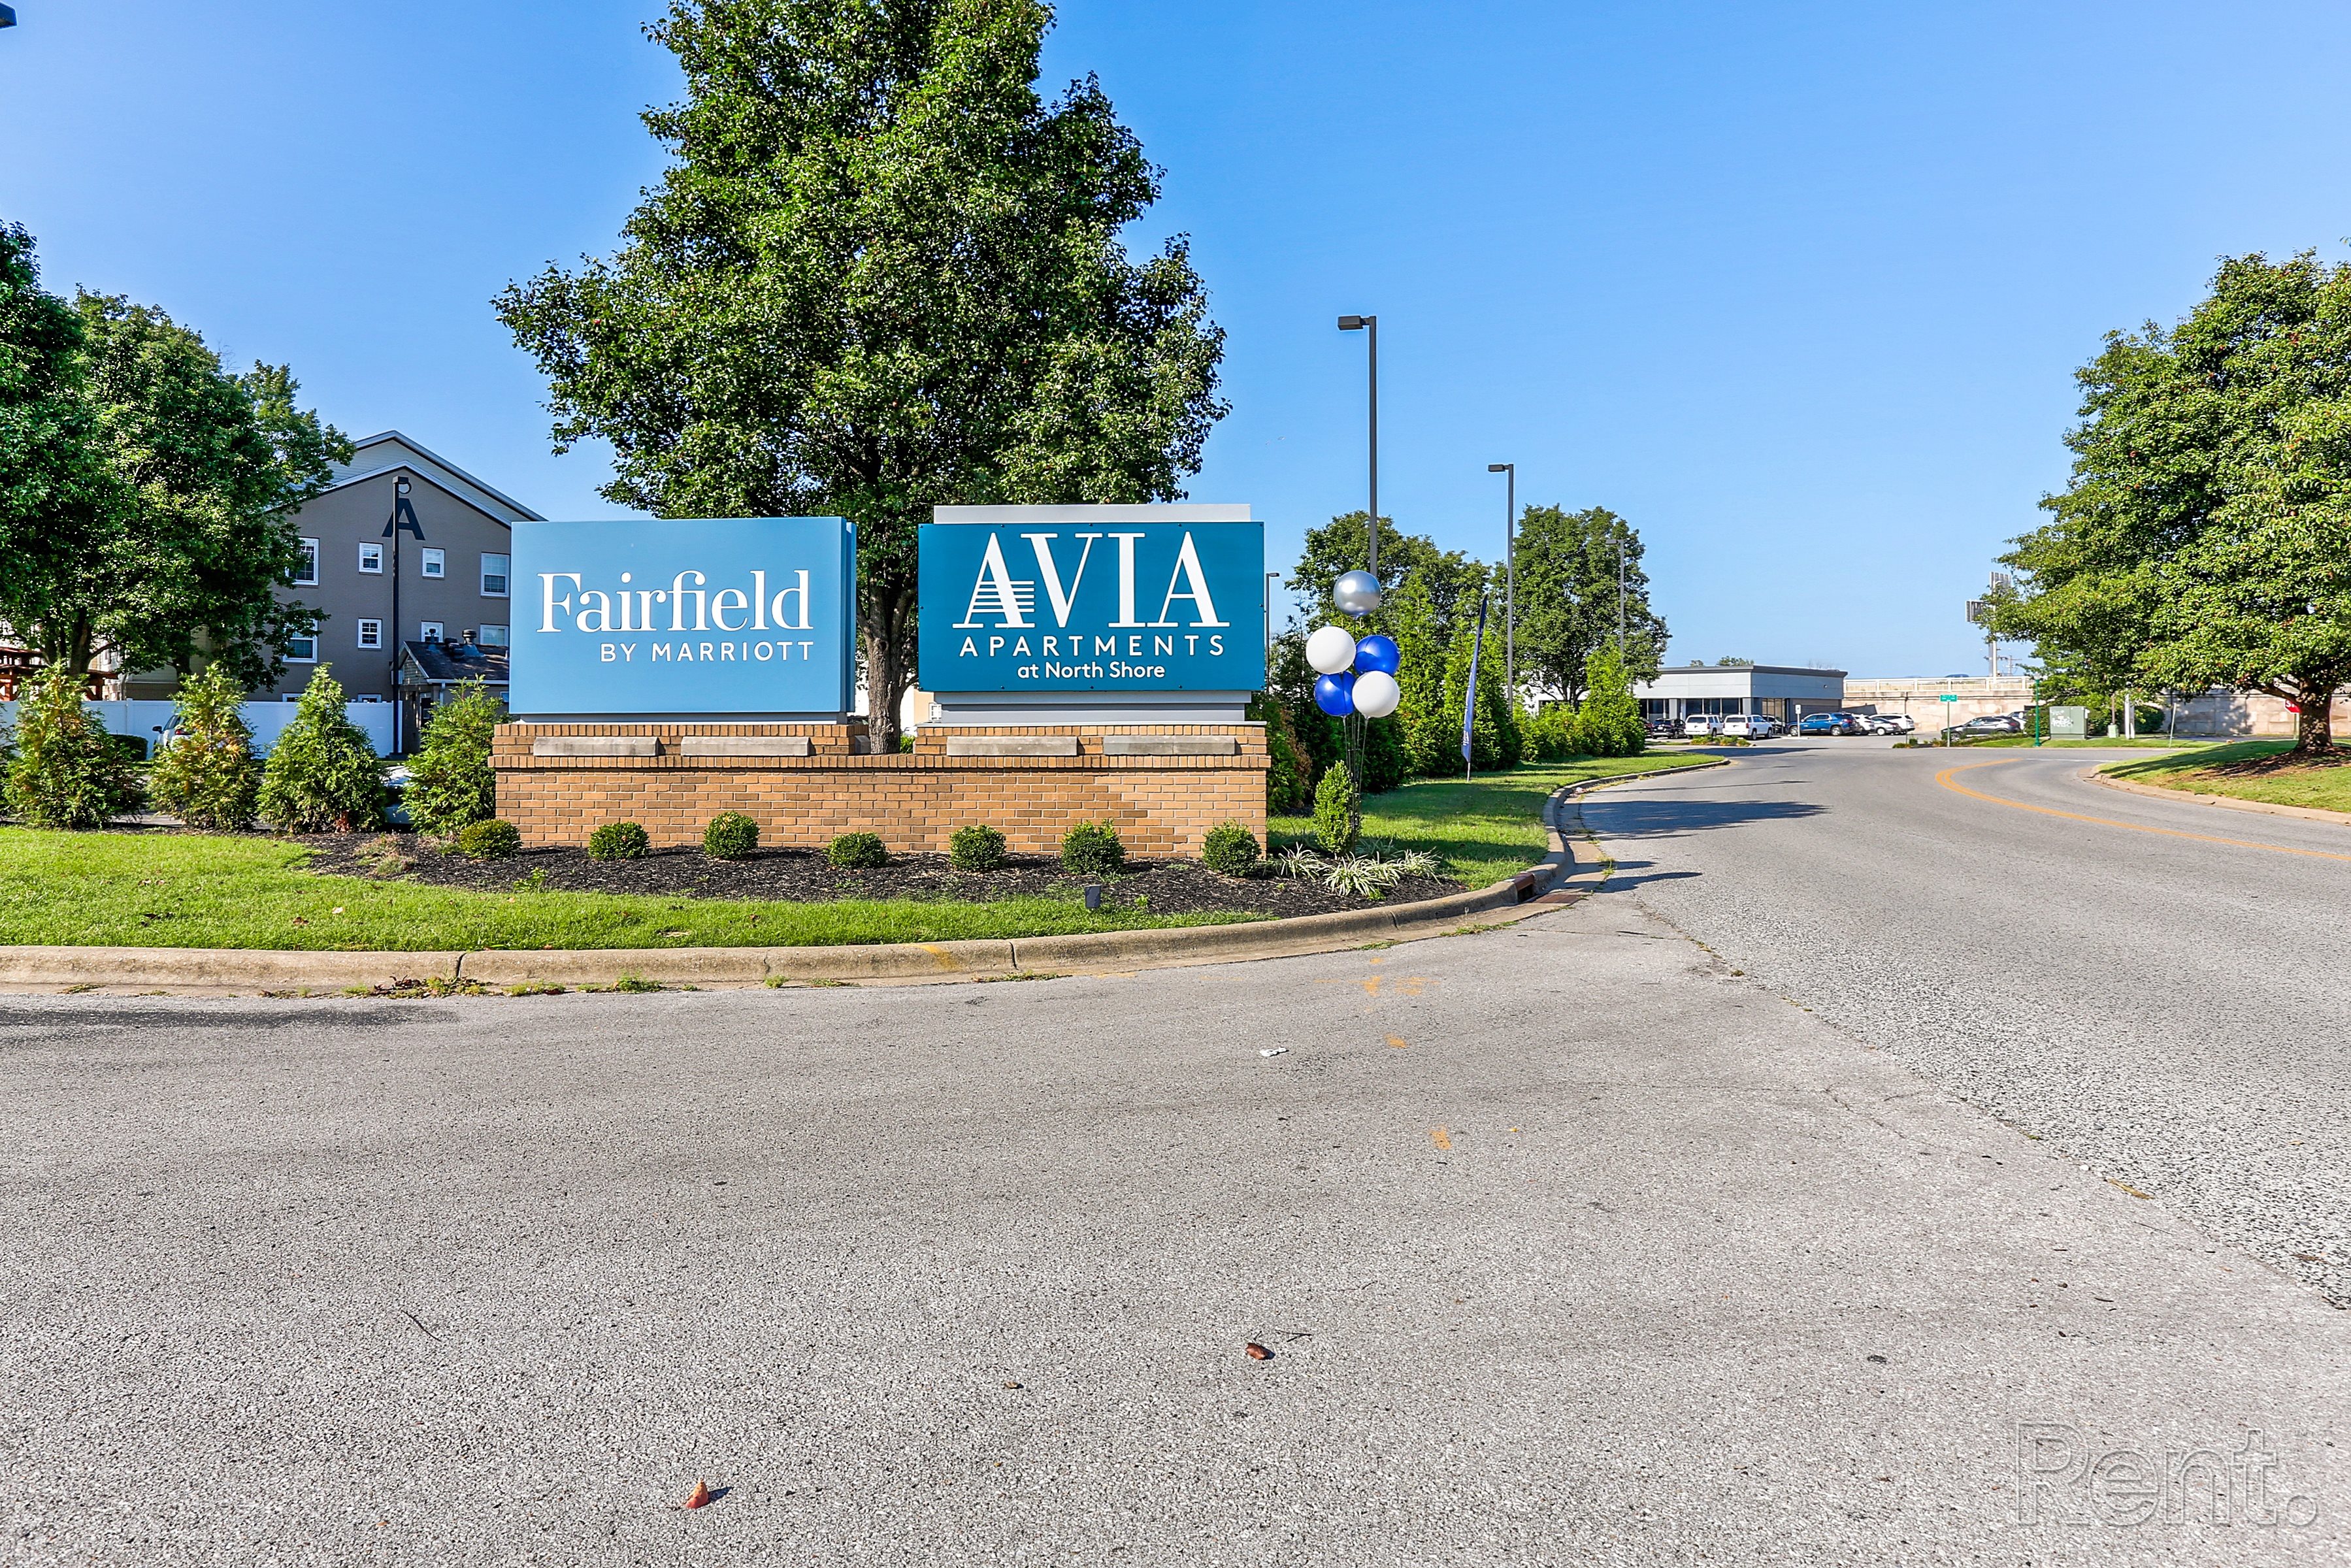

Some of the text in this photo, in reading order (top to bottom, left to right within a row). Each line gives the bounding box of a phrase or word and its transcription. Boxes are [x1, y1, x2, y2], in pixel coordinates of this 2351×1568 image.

[382, 498, 425, 540] A
[952, 532, 1230, 629] AVIA
[536, 570, 814, 632] Fairfield
[600, 642, 814, 662] BY MARRIOTT
[959, 635, 1224, 657] APARTMENTS
[1017, 661, 1165, 679] at North Shore
